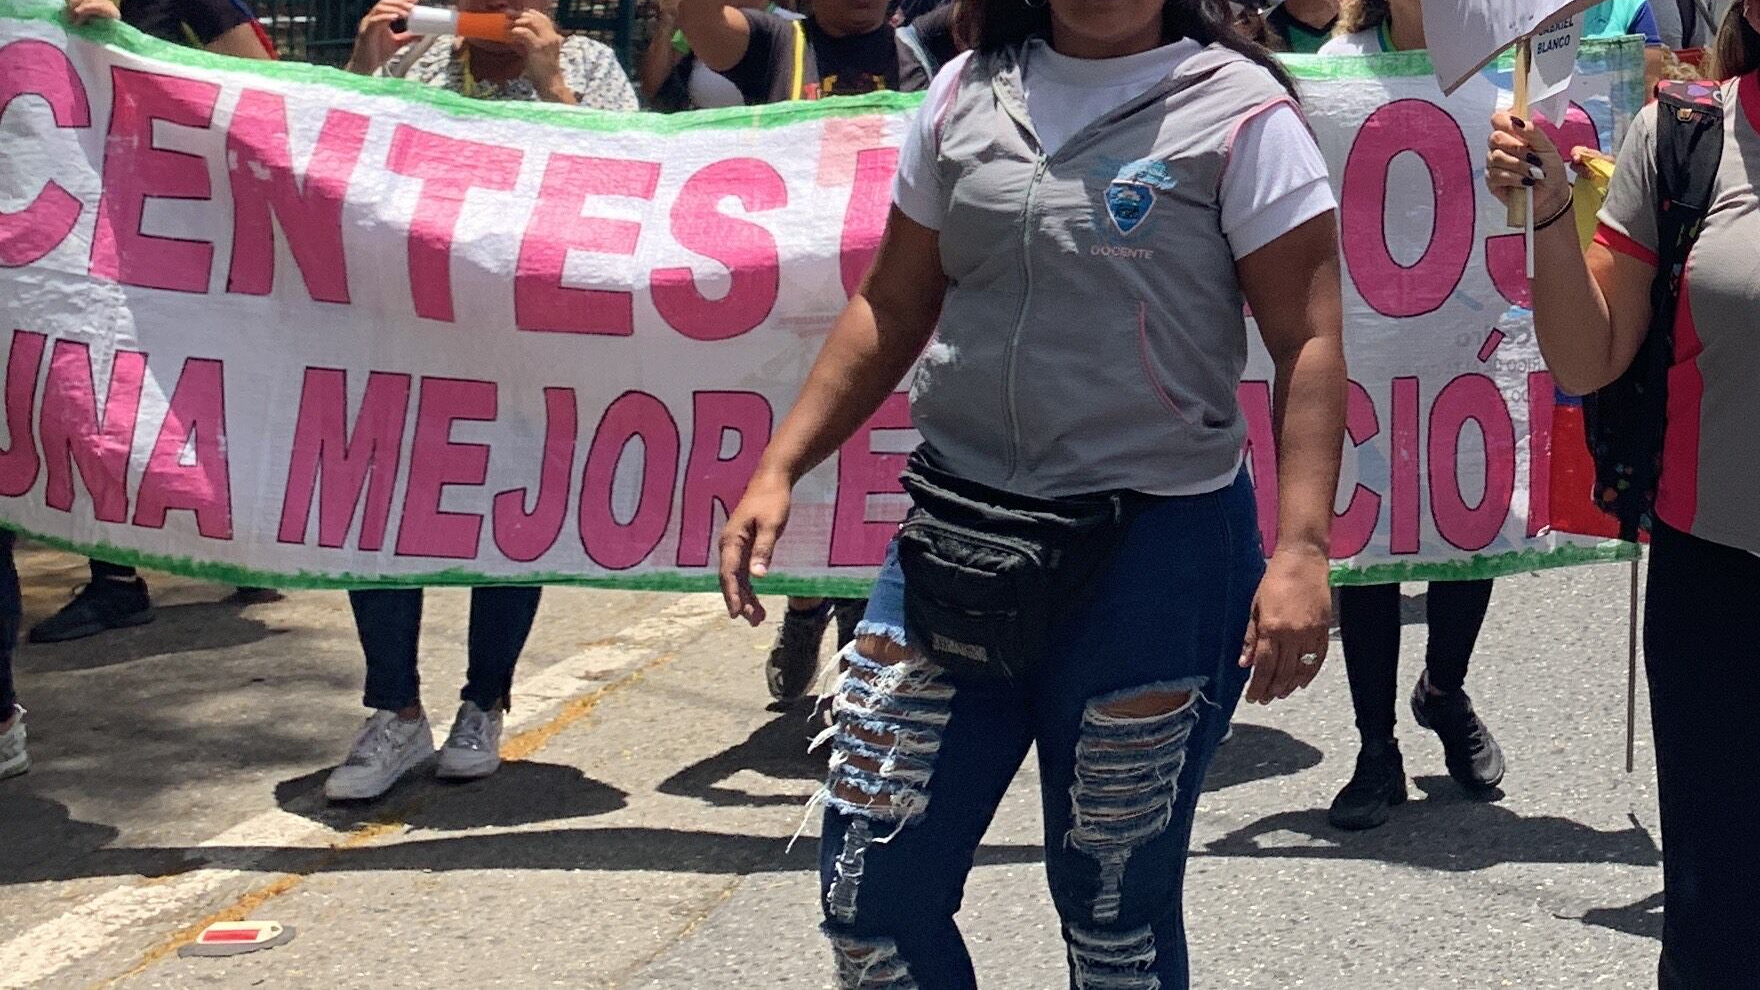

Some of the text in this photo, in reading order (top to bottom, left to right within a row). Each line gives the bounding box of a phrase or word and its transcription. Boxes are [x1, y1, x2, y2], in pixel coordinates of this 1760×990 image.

[1537, 33, 1571, 55] BLANCO
[0, 39, 788, 342] CENTES
[276, 365, 774, 572] MEJOR
